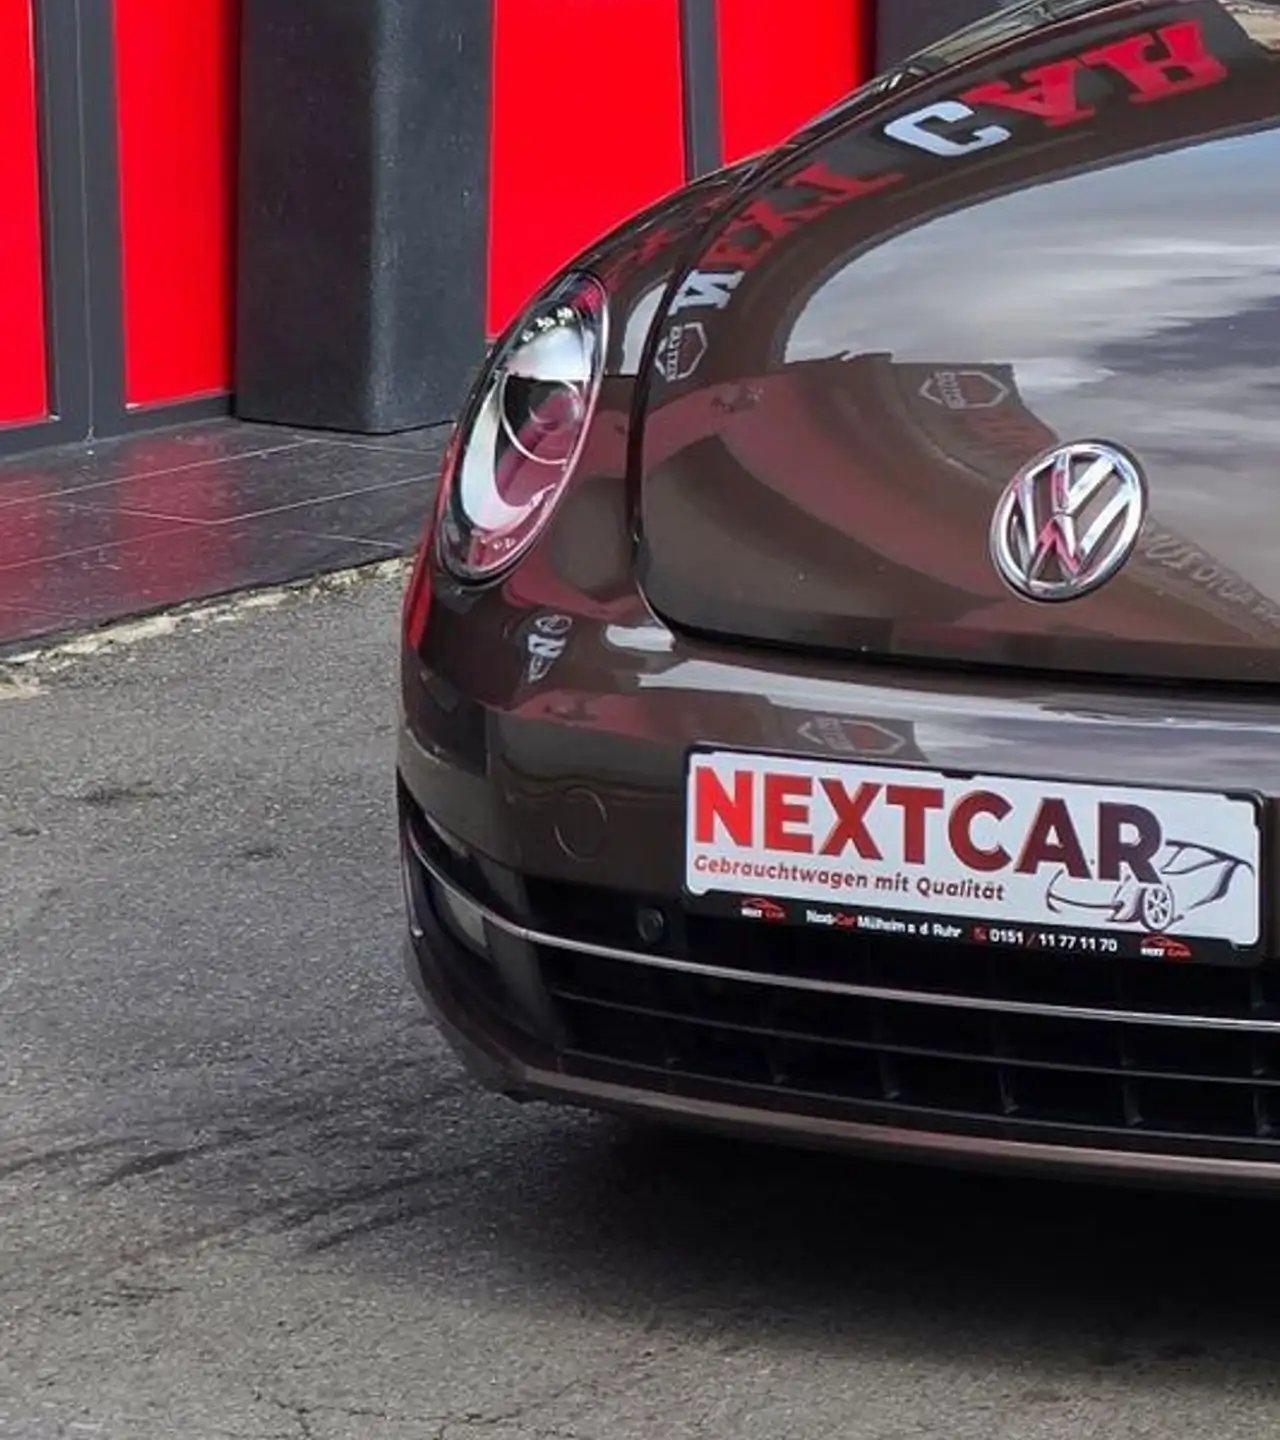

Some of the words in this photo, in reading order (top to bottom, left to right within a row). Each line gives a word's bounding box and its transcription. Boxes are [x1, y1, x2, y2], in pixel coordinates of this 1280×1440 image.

[693, 764, 1164, 885] NEXTCAR
[693, 854, 869, 895] Gebrauchtwagen
[875, 873, 910, 894] mit
[916, 876, 1006, 903] Qualität
[932, 923, 963, 938] Ruhr
[989, 927, 1024, 946] 0151
